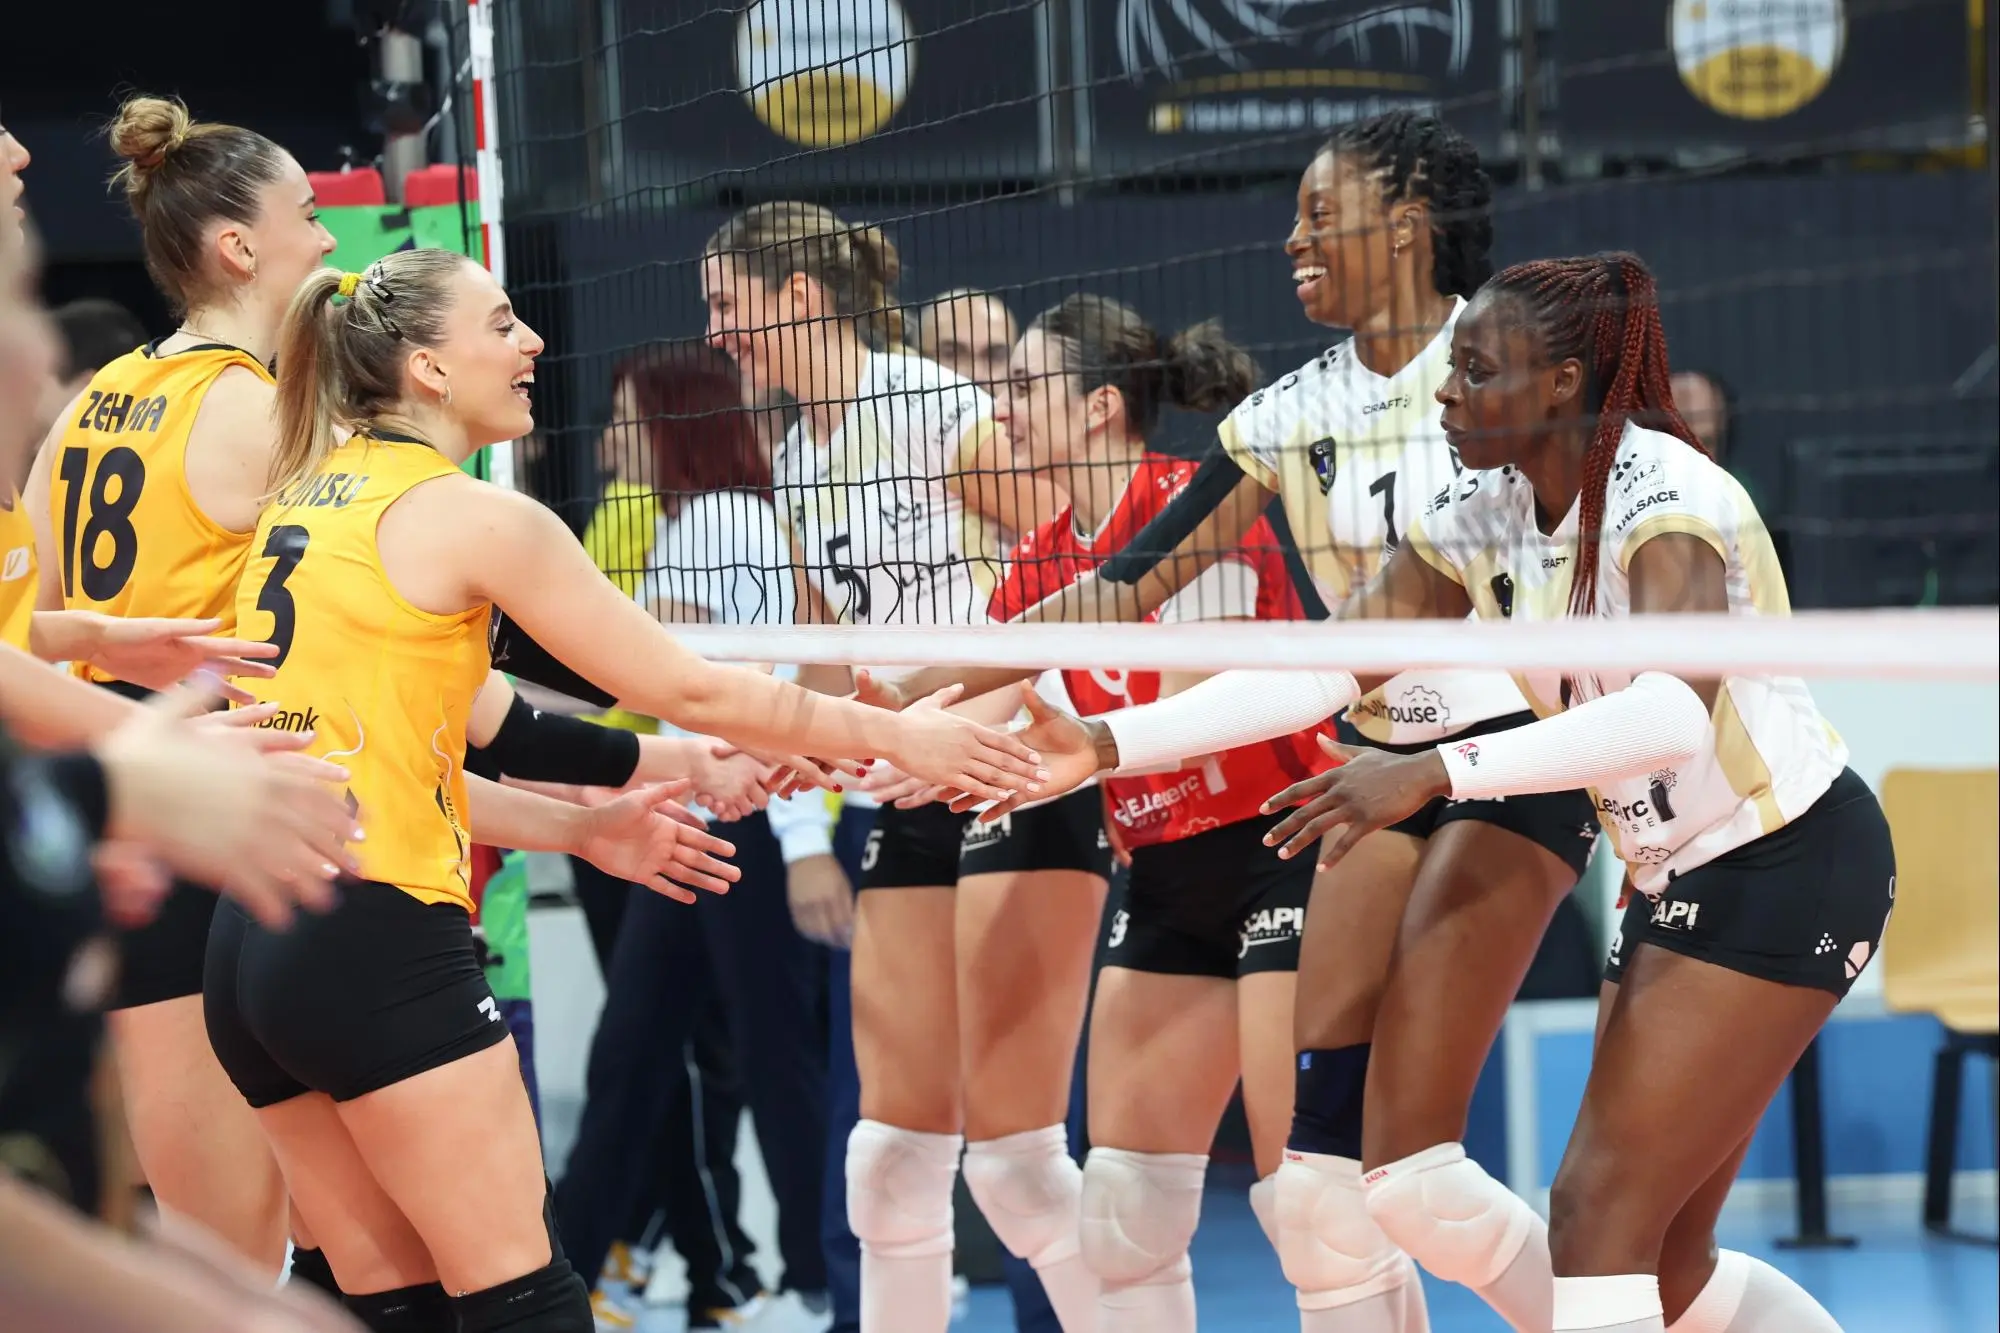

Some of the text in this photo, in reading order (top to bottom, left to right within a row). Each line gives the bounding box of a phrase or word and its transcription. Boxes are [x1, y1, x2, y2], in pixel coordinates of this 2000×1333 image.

[60, 446, 145, 601] 18
[238, 525, 310, 677] 3
[826, 534, 869, 617] 5
[861, 829, 884, 871] 5
[1244, 907, 1304, 933] CAPI
